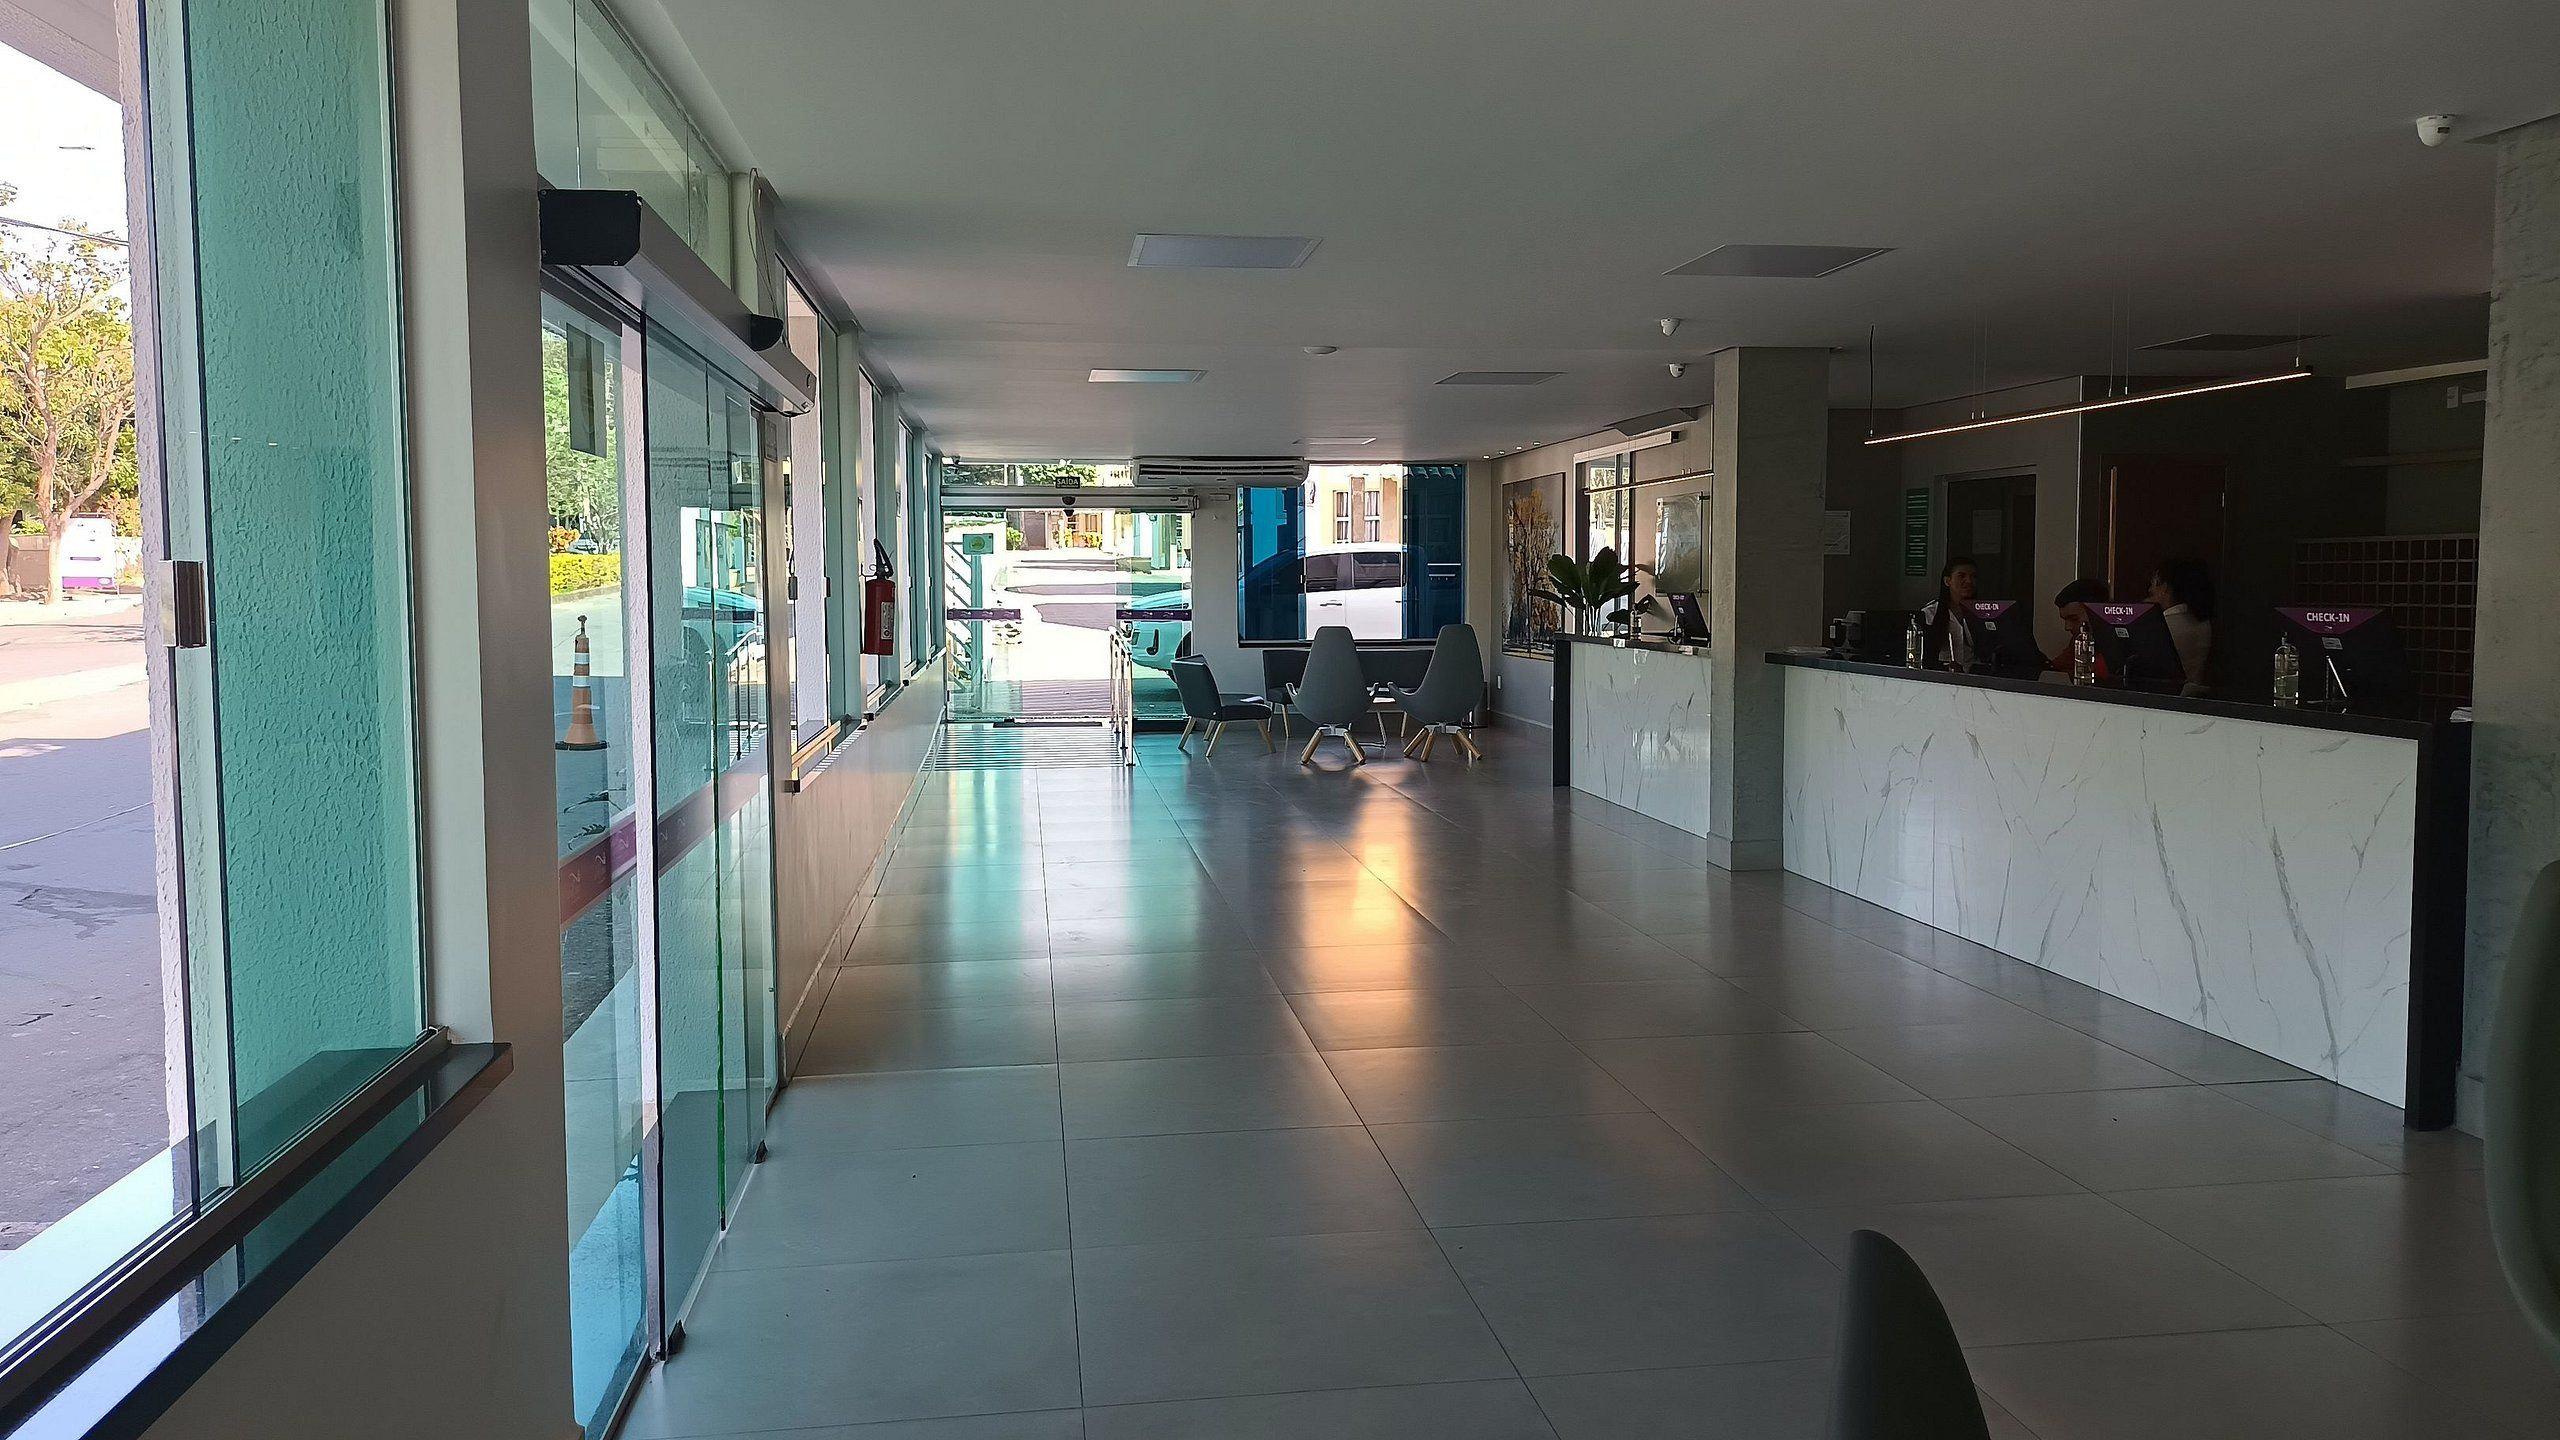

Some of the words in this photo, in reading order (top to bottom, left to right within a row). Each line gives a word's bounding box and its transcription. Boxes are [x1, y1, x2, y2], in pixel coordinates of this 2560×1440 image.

[1975, 602, 1999, 611] CHECK-IN
[2104, 606, 2134, 615] CHECK-IN
[2306, 612, 2350, 623] CHECK-IN
